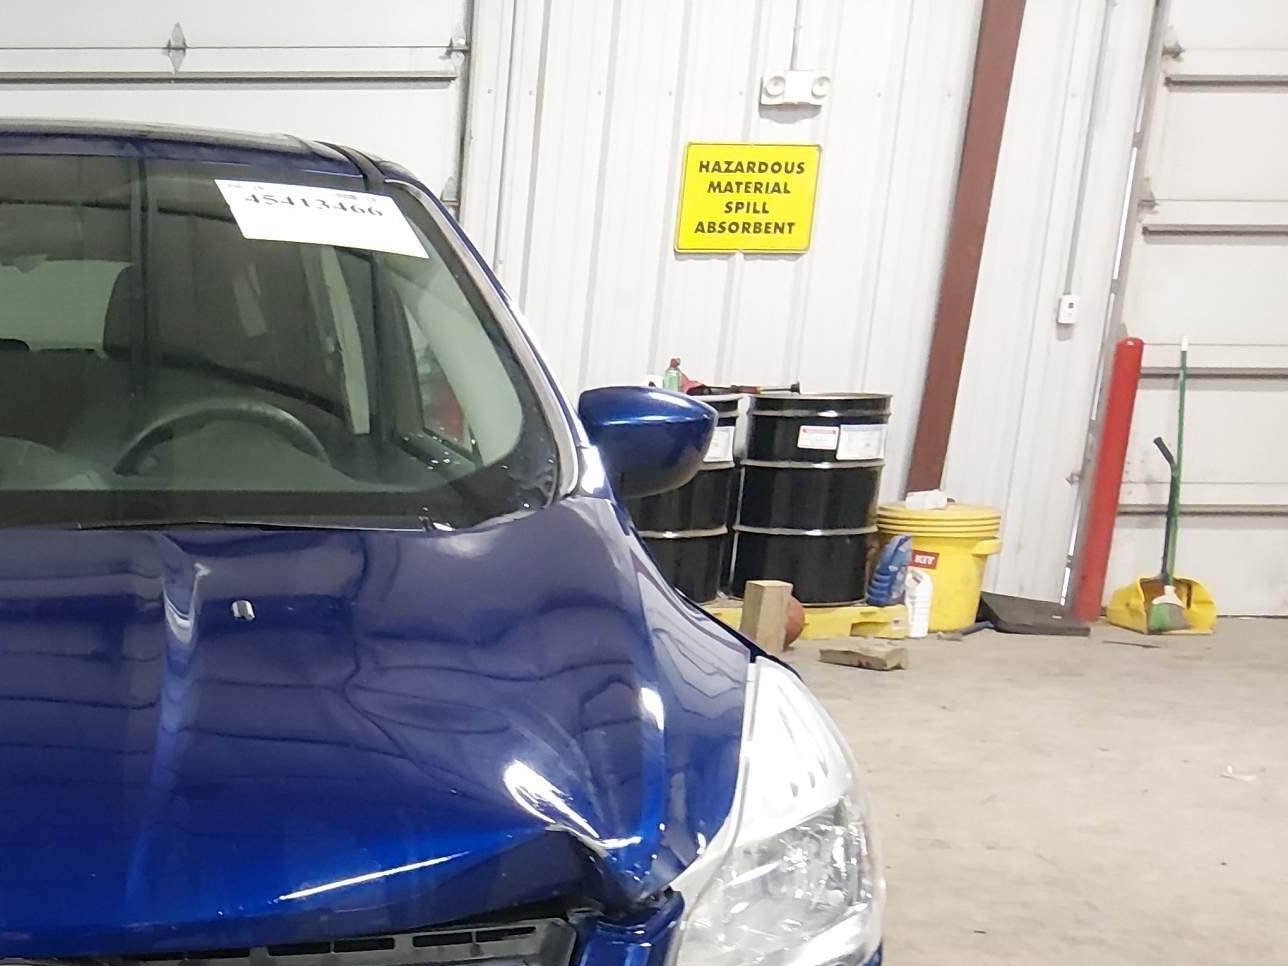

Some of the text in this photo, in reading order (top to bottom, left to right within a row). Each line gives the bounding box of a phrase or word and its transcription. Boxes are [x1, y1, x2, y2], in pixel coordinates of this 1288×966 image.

[698, 160, 805, 174] HAZARDOUS
[707, 181, 791, 194] MATERIAL
[245, 193, 384, 217] 45413466
[724, 201, 770, 214] SPILL
[694, 221, 796, 234] ABSORBENT
[915, 554, 935, 565] KIT
